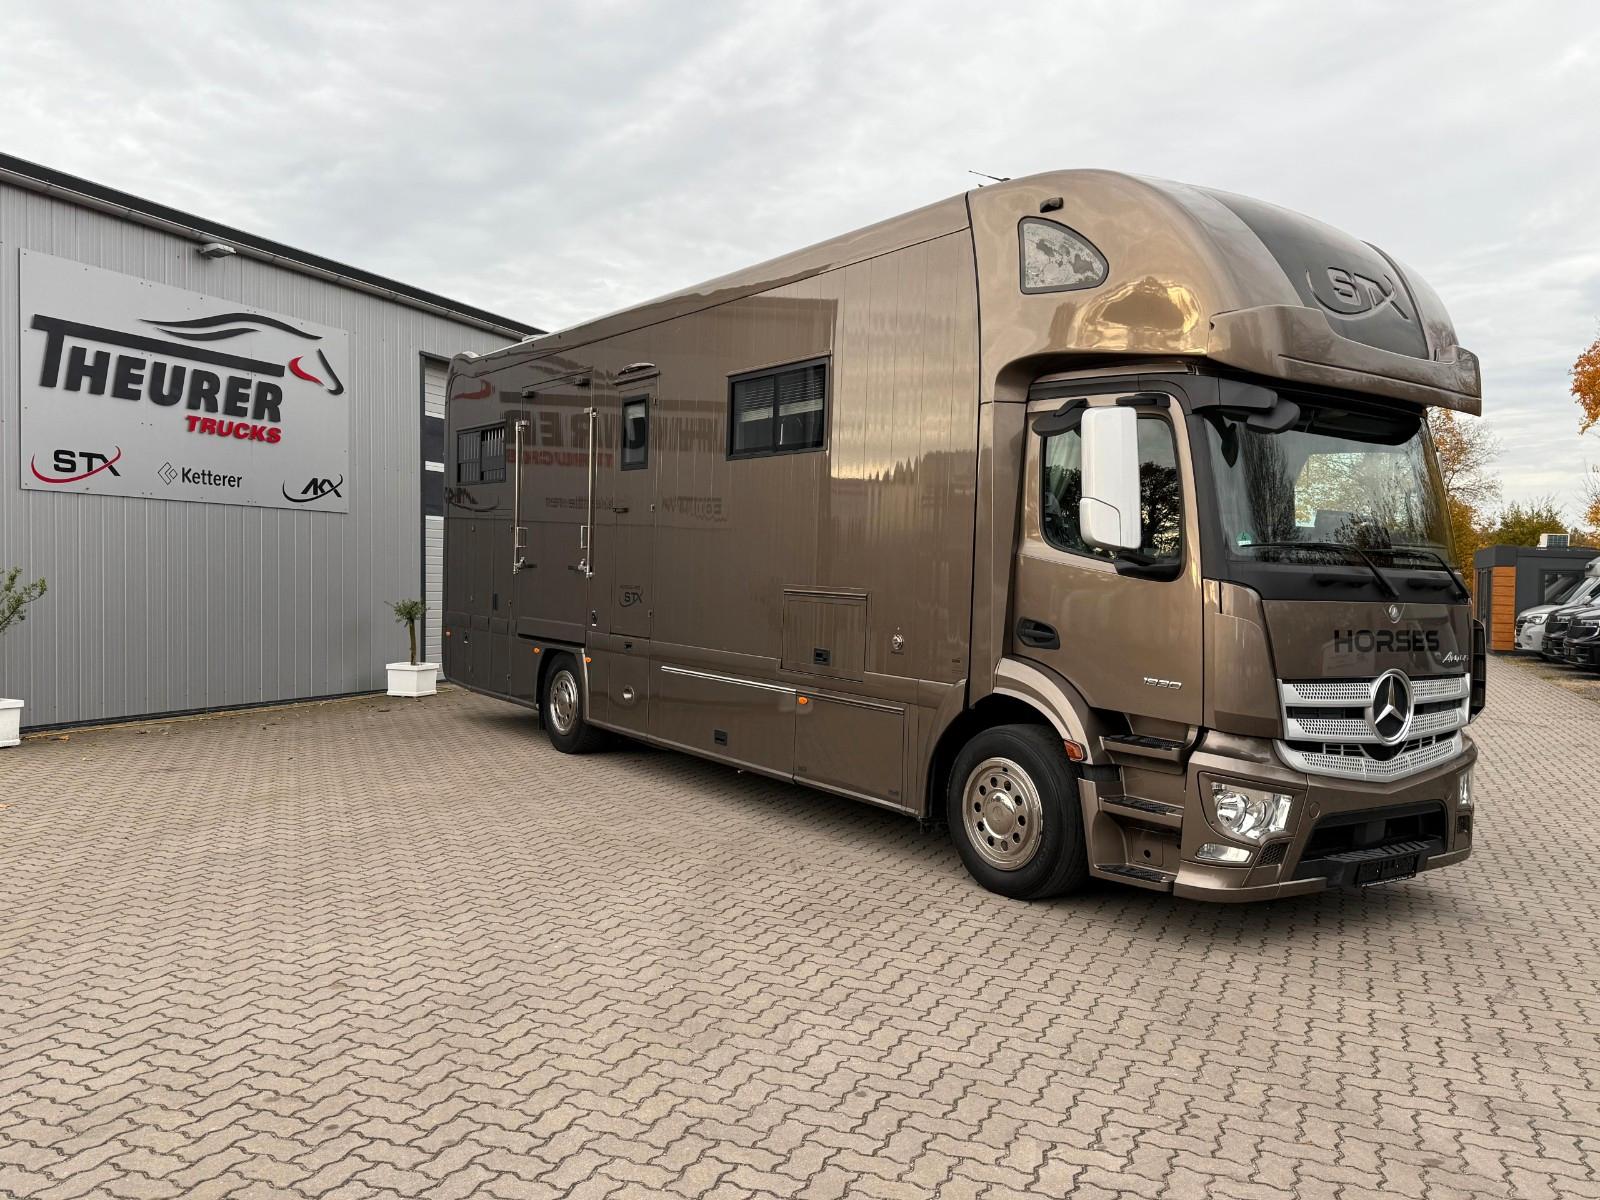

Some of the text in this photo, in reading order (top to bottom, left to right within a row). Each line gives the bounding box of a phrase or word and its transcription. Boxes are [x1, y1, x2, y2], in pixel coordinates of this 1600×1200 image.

[1327, 265, 1409, 321] STX
[30, 313, 286, 423] THEURER
[185, 415, 282, 444] TRUCKS
[53, 449, 121, 477] STX
[181, 467, 243, 488] Ketterer
[1333, 629, 1440, 653] HORSES
